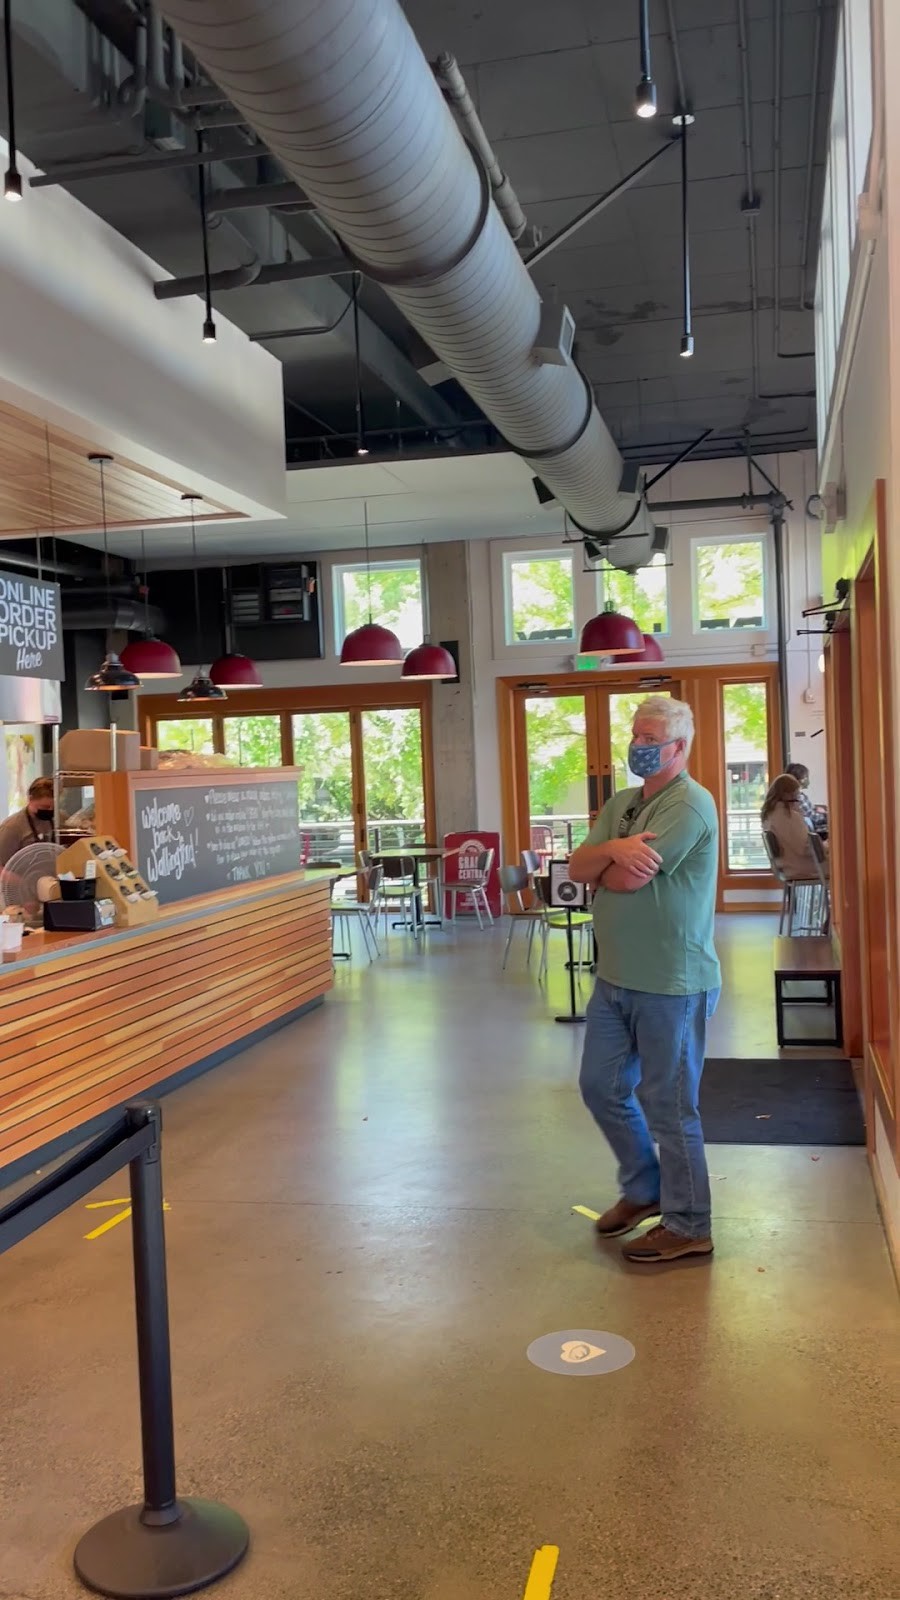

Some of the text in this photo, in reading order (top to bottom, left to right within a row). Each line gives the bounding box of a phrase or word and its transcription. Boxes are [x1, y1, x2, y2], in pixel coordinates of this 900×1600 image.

[0, 601, 57, 632] ORDER
[0, 624, 57, 650] PICKUP
[16, 648, 43, 671] Here
[152, 825, 182, 852] back
[458, 856, 479, 869] GRA
